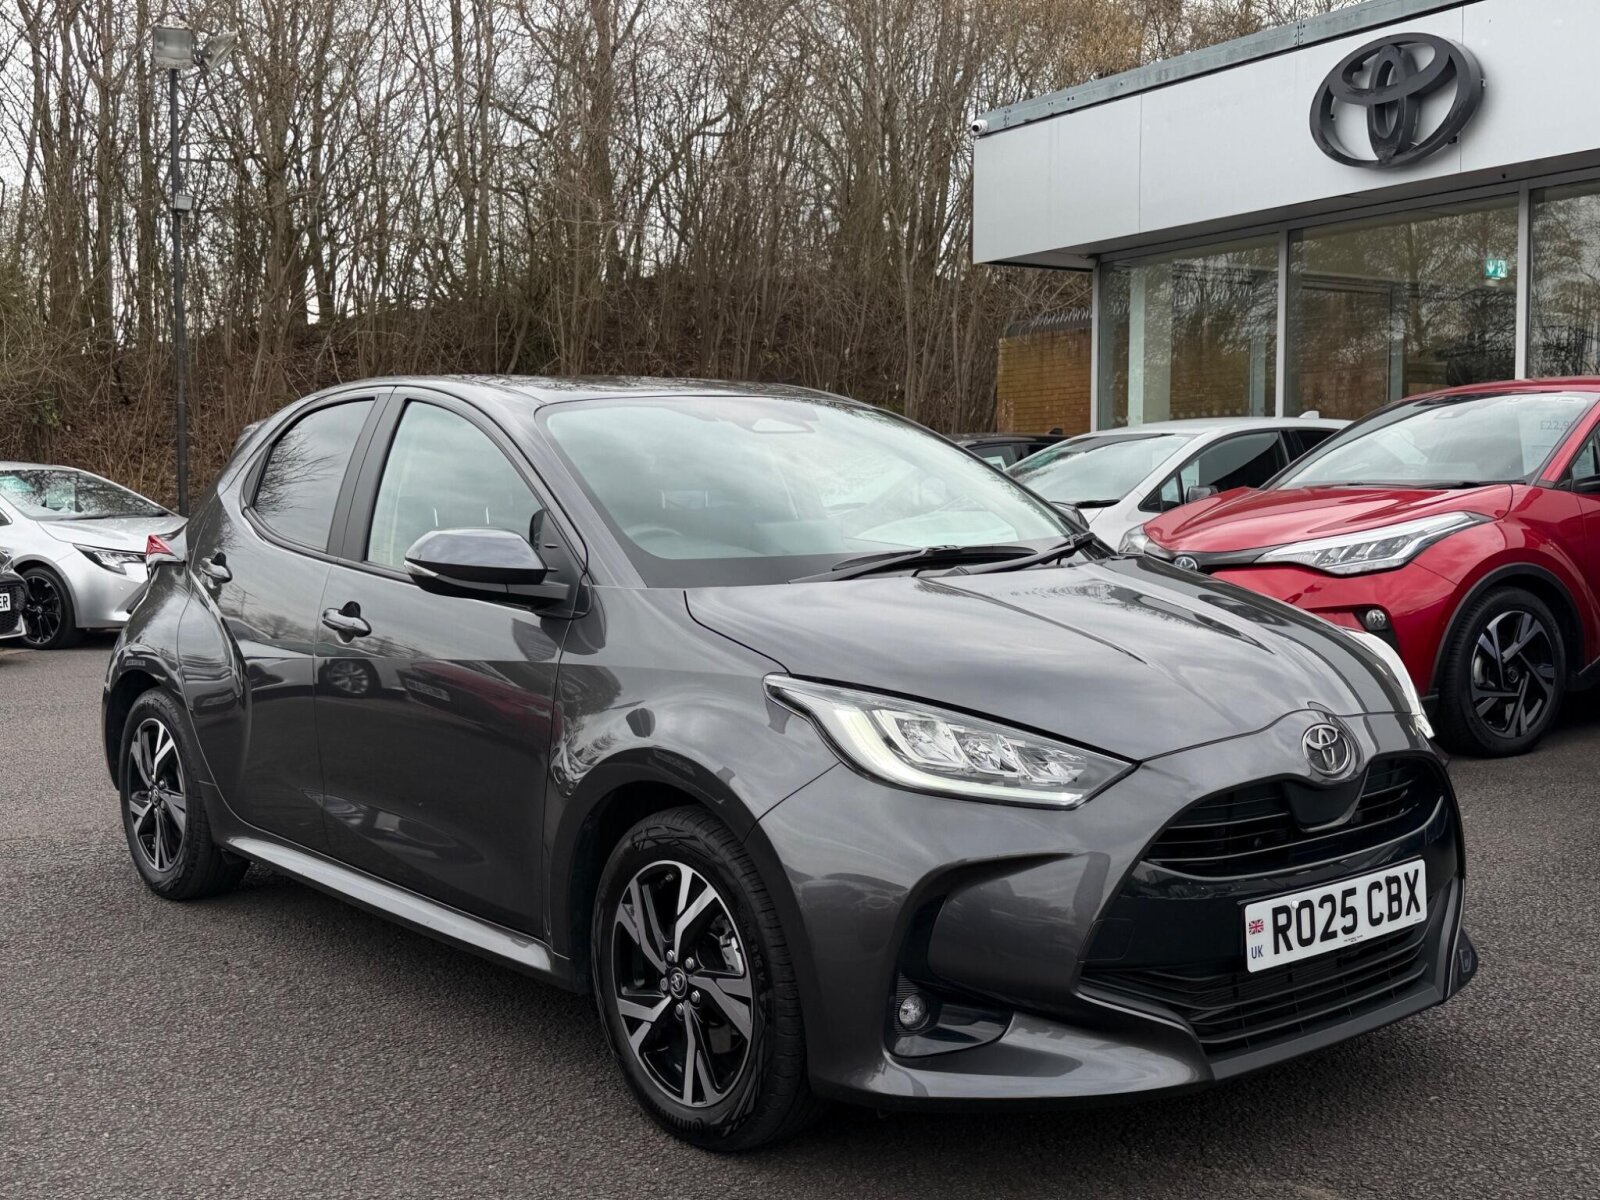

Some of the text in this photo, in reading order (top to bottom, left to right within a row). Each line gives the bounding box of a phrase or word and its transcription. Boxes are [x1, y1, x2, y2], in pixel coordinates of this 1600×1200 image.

[1540, 420, 1570, 432] £22,9
[1271, 869, 1420, 955] RO25 CBX
[1251, 945, 1264, 959] UK
